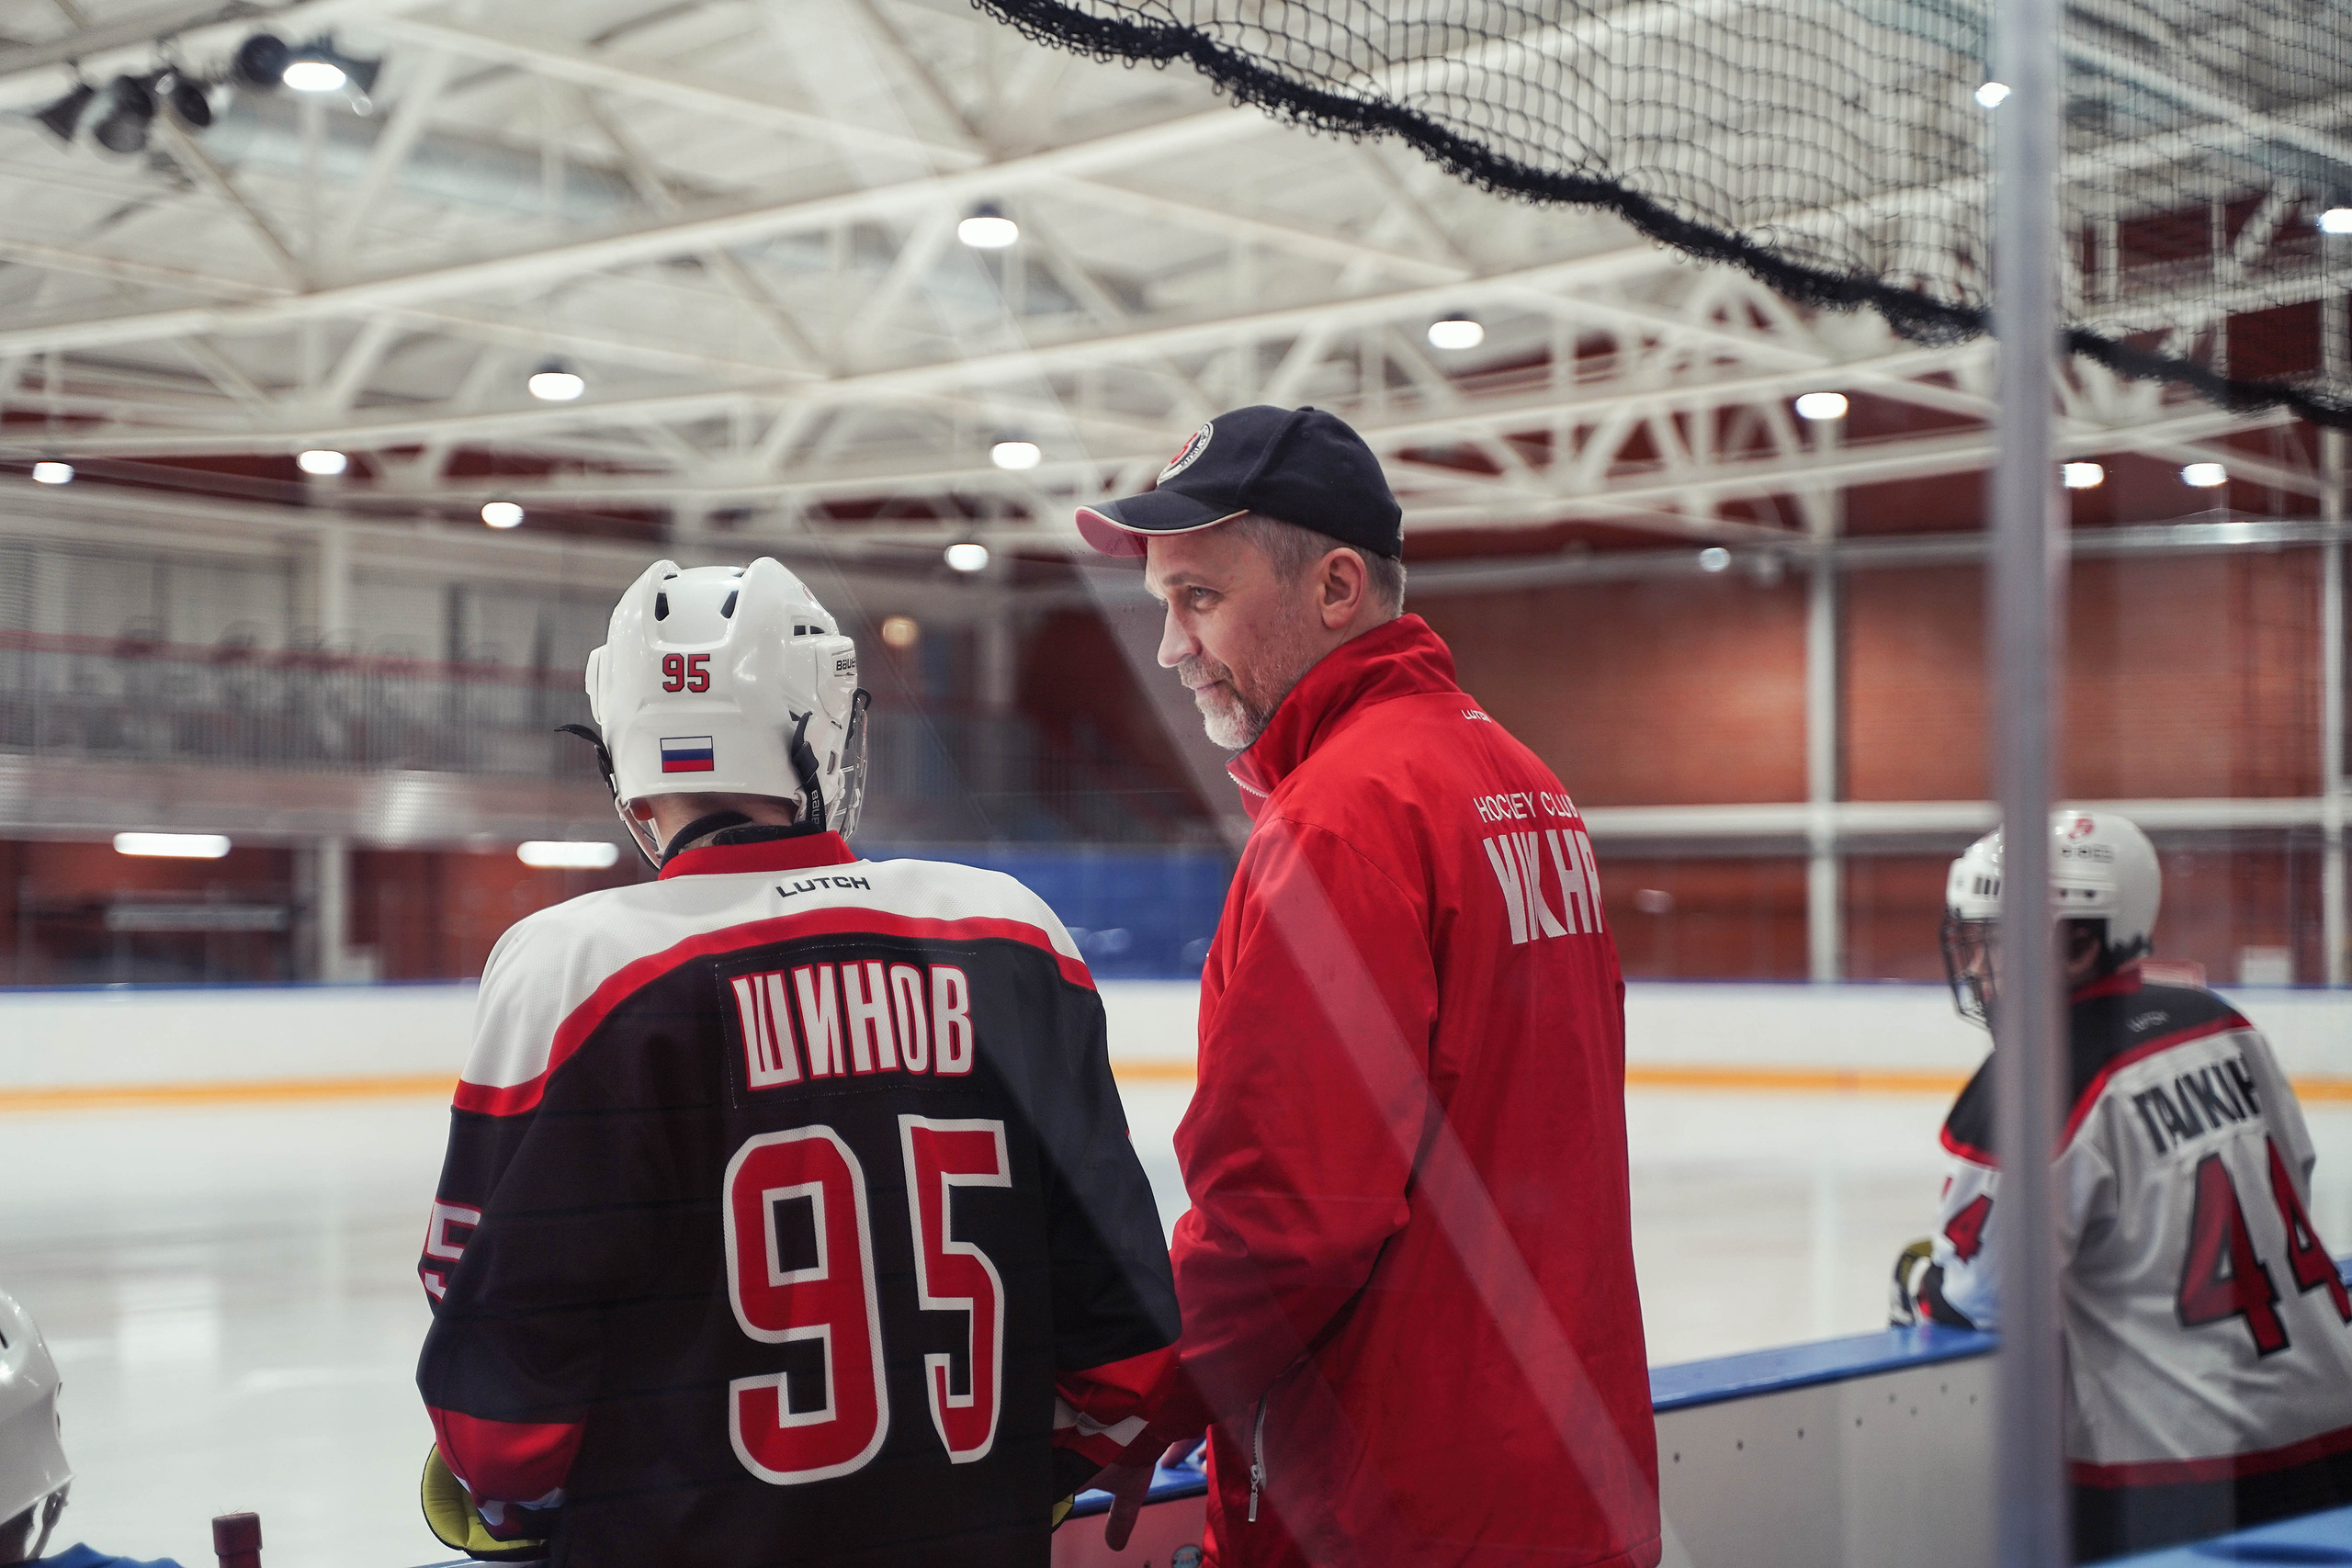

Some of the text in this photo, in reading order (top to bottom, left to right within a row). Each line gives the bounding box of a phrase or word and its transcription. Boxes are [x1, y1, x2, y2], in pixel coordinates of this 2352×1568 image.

[662, 653, 710, 693] 95
[836, 657, 856, 671] Baue
[775, 876, 871, 898] LUTCH
[729, 959, 974, 1091] ШИНОВ
[2174, 1135, 2352, 1359] 44
[723, 1114, 1012, 1485] 95
